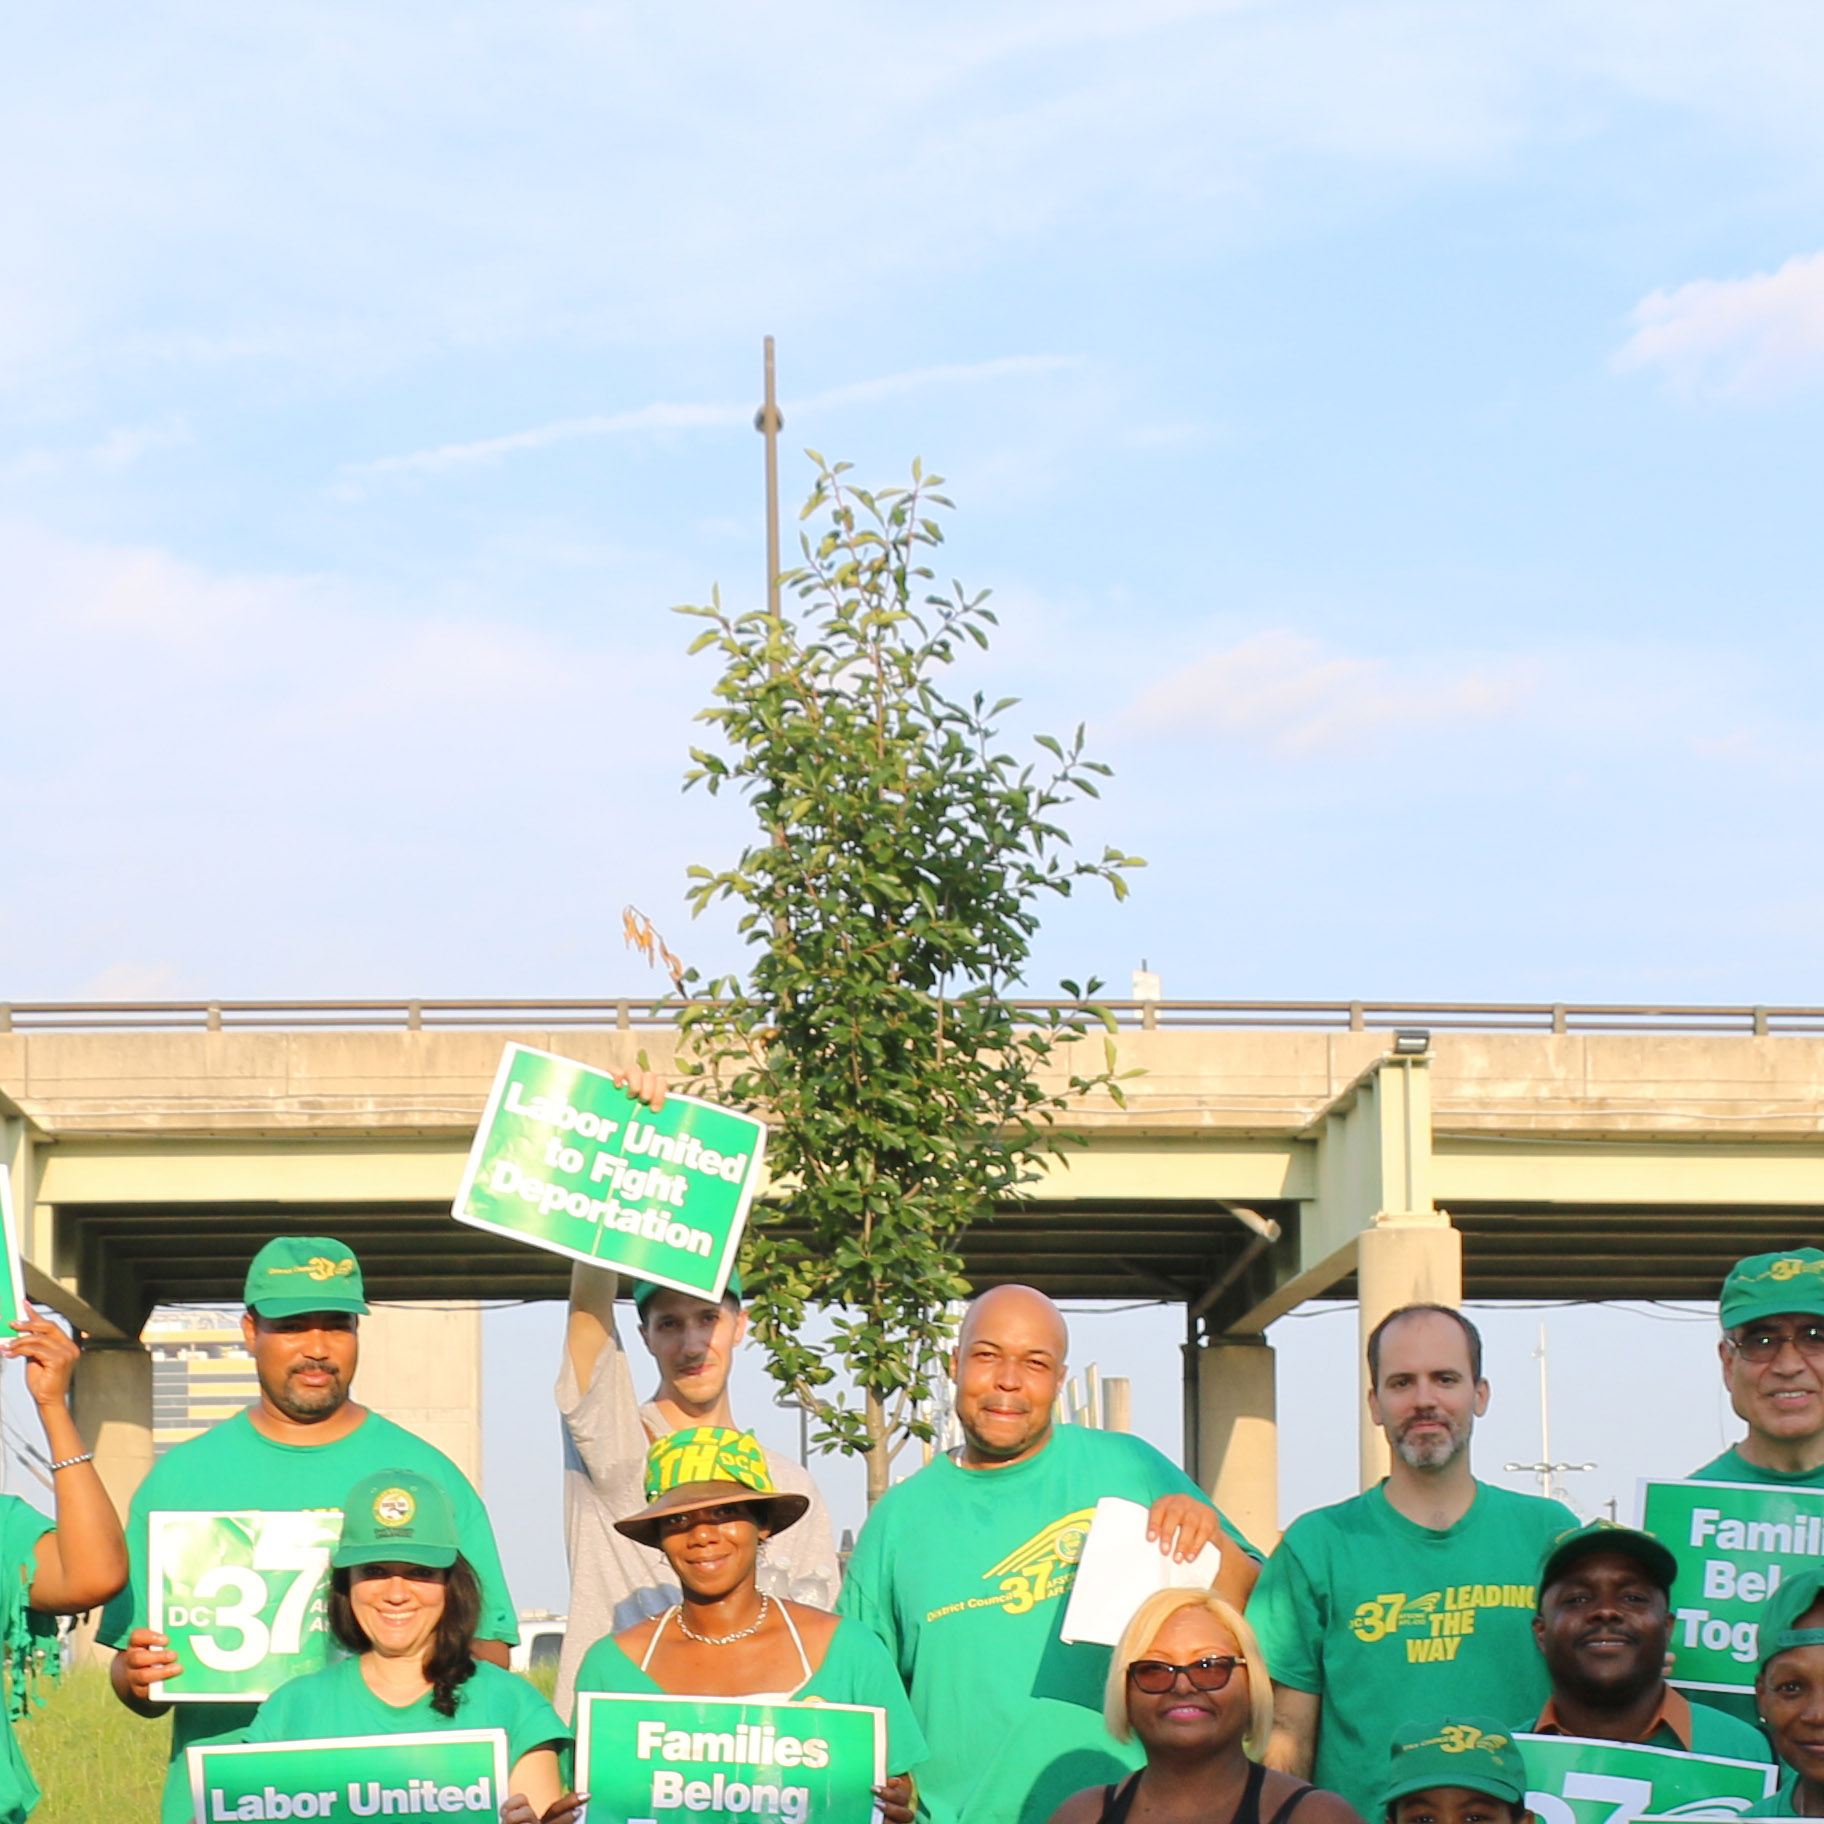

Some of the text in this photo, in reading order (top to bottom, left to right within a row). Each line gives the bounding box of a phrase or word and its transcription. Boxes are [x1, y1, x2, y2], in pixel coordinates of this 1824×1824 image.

[503, 1081, 748, 1184] Labor United
[544, 1136, 688, 1206] to Fight
[490, 1159, 714, 1257] Deportation
[719, 1452, 750, 1470] DC
[999, 1560, 1055, 1615] 37
[1703, 1559, 1782, 1603] Bel
[168, 1605, 213, 1627] DC
[188, 1547, 331, 1672] 37
[1354, 1592, 1407, 1642] 37
[1428, 1609, 1475, 1637] THE
[1406, 1636, 1462, 1663] WAY
[637, 1720, 831, 1770] Families
[1440, 1724, 1484, 1754] 37
[211, 1776, 492, 1822] Labor United
